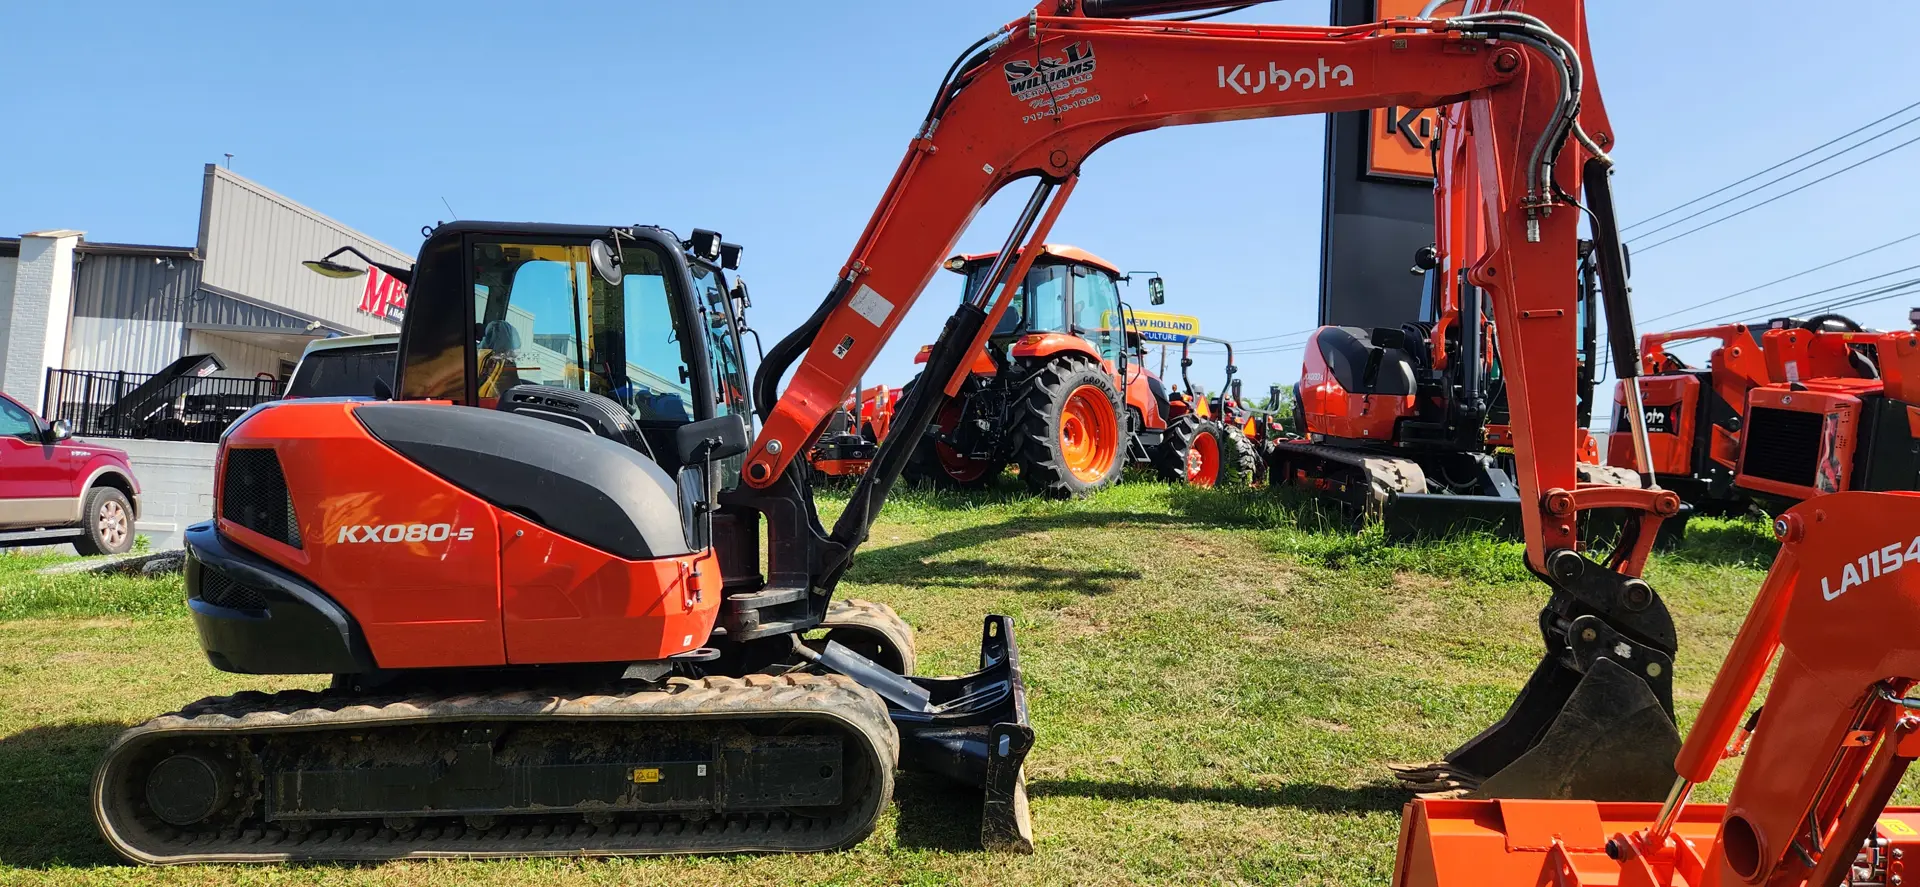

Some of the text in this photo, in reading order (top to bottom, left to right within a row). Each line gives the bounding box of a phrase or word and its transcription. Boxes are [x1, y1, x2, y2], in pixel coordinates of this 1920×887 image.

[1003, 41, 1096, 83] S&L
[1011, 60, 1096, 96] WILLIAMS
[1217, 57, 1355, 95] Kubota
[1018, 80, 1071, 102] SERVICES
[1072, 73, 1093, 85] LLC
[358, 264, 409, 318] ME
[1126, 317, 1193, 331] NEW HOLLAND
[337, 523, 475, 544] KX080-5
